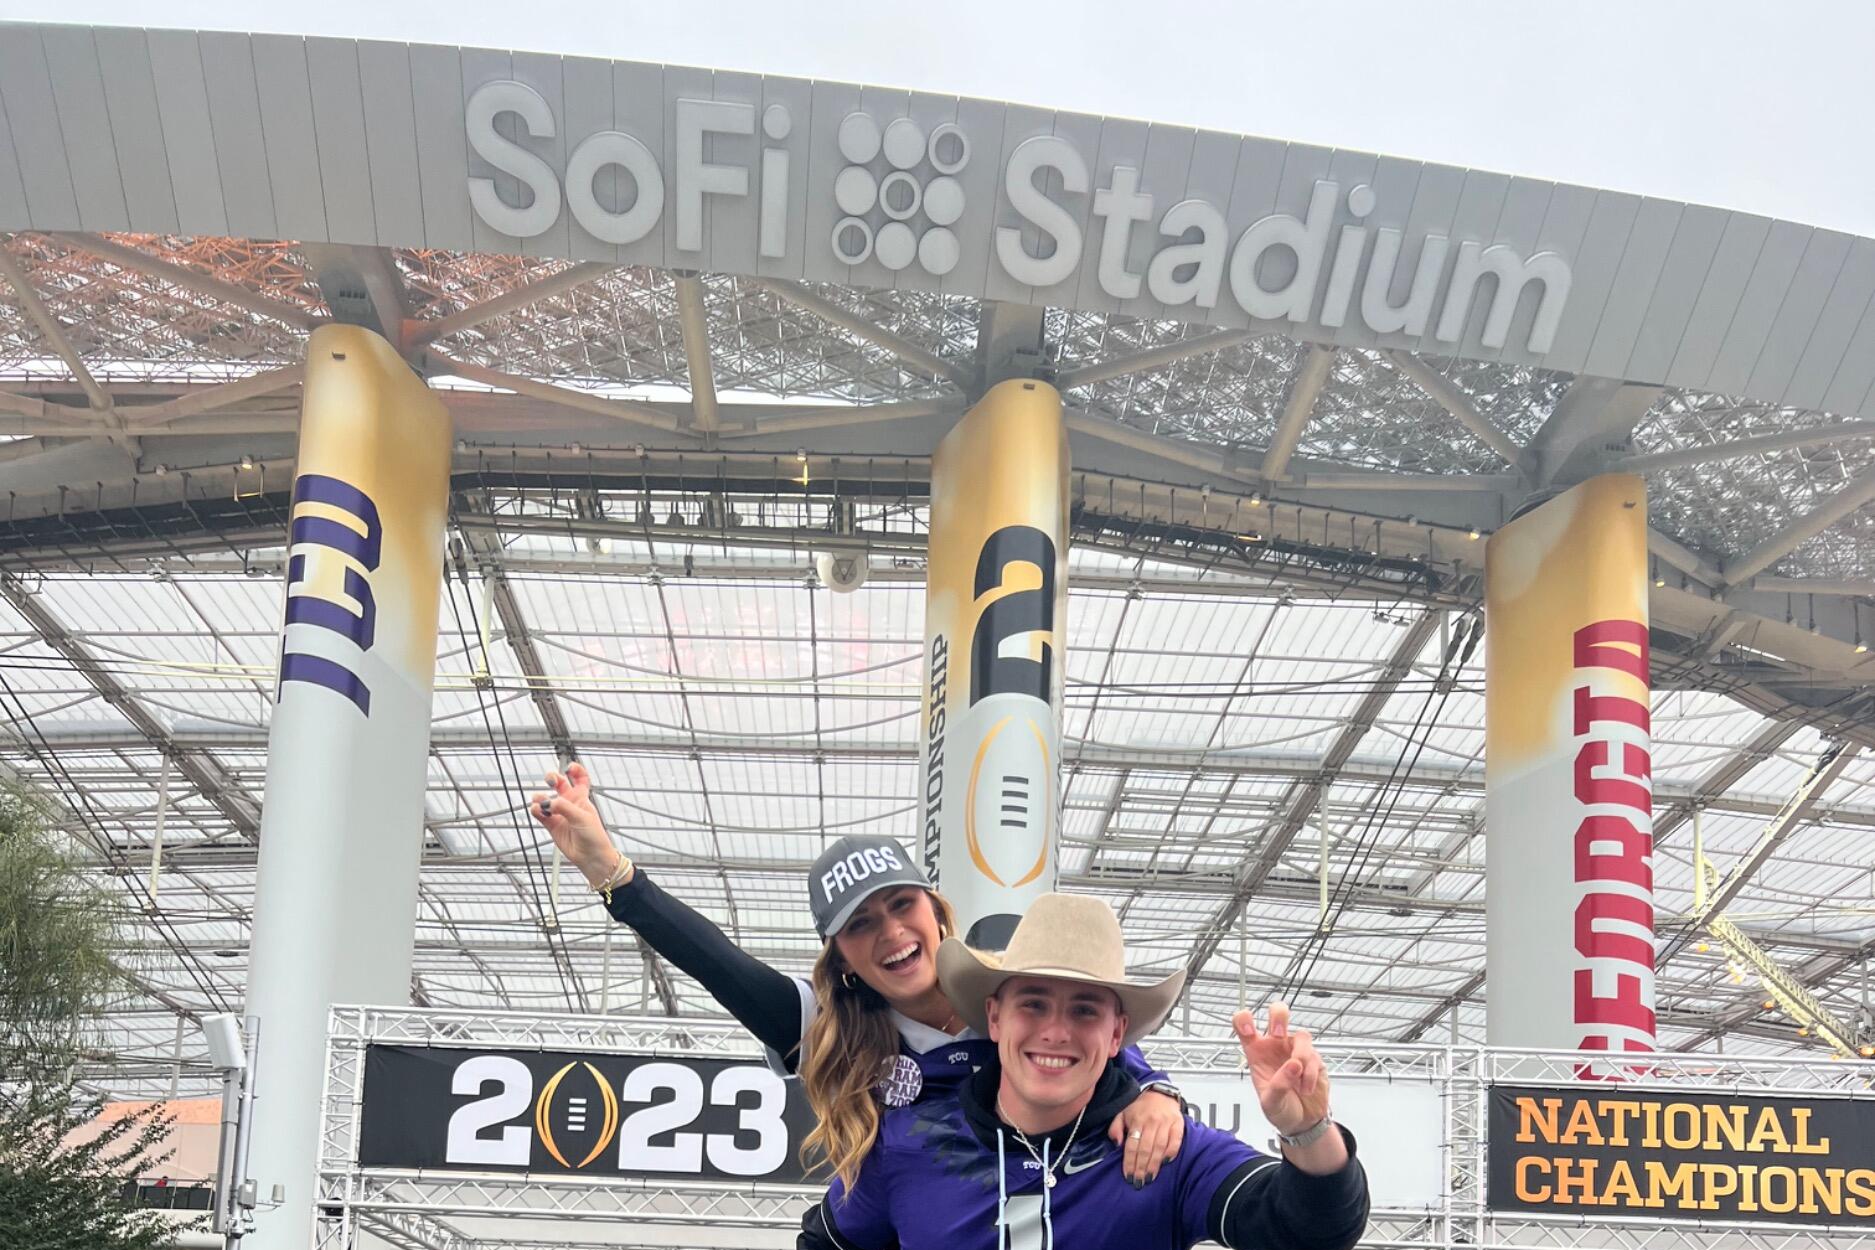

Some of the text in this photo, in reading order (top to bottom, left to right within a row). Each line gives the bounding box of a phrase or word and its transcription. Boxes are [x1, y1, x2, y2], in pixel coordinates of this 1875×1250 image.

[466, 80, 1572, 354] SoFi Stadium
[277, 473, 382, 719] TCU
[820, 846, 903, 905] FROGS
[948, 1051, 968, 1064] TCU
[1515, 1097, 1830, 1154] NATIONAL
[1515, 1156, 1875, 1216] CHAMPIONS
